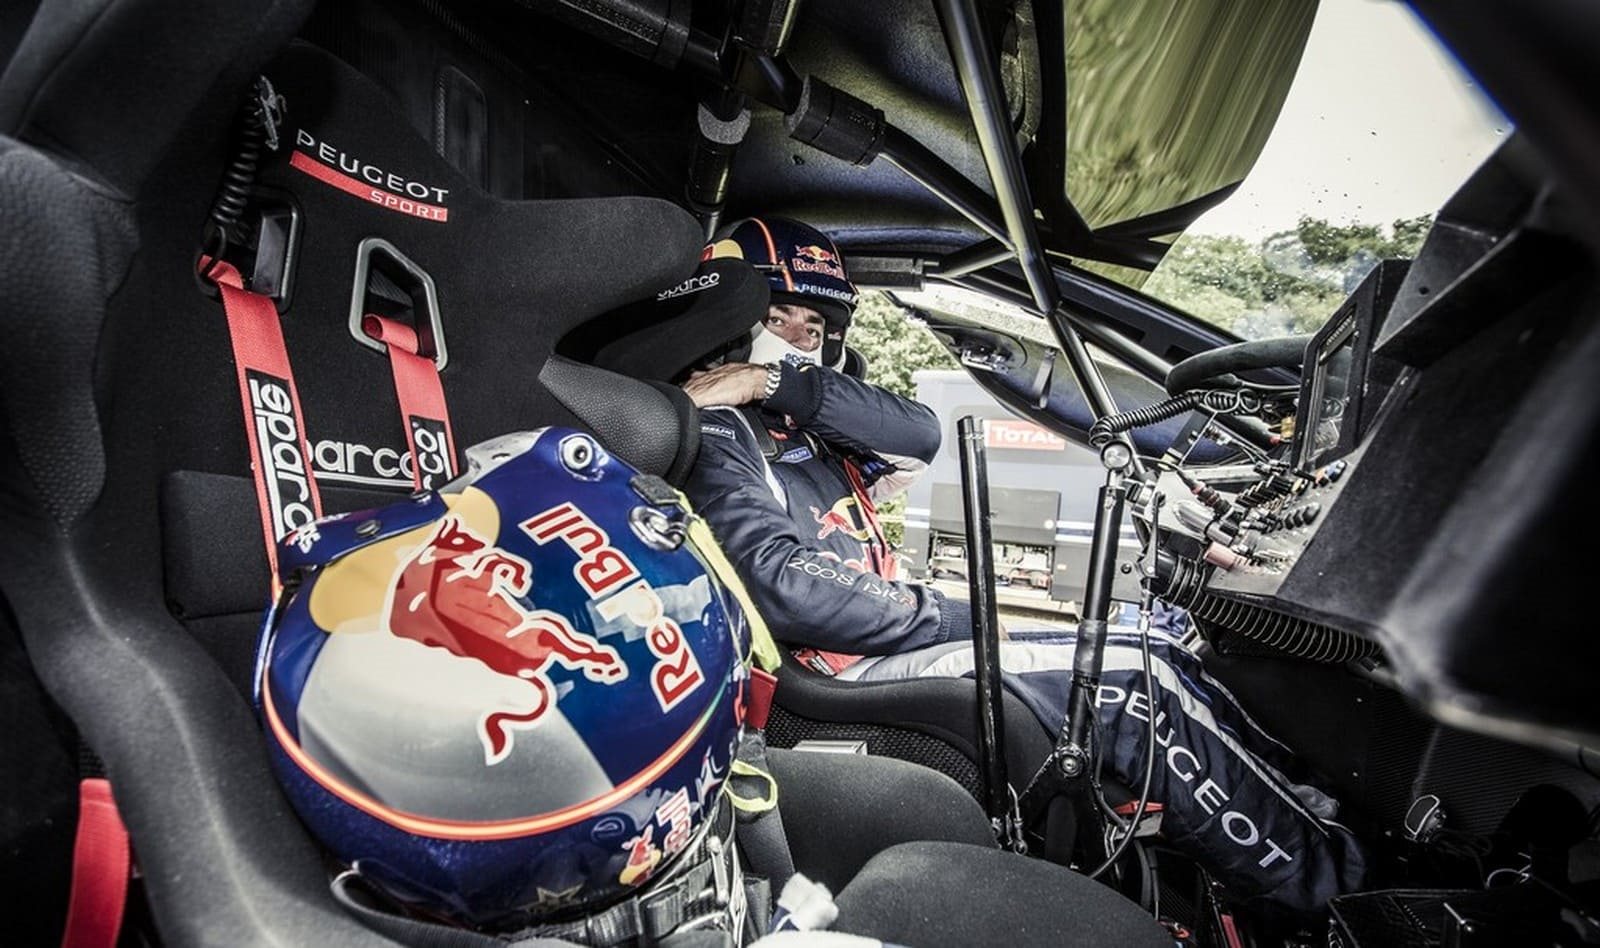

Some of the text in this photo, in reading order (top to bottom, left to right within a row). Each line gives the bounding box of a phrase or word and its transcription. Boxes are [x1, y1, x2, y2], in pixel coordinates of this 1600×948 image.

[296, 129, 449, 203] PEUGEOT
[371, 190, 442, 219] SPORT
[803, 283, 853, 301] PEUGEOT
[252, 380, 315, 533] sparc
[991, 426, 1058, 445] TOTAL
[521, 503, 639, 598] Bull
[788, 559, 854, 586] 2008
[1094, 685, 1293, 869] PEUGEOT
